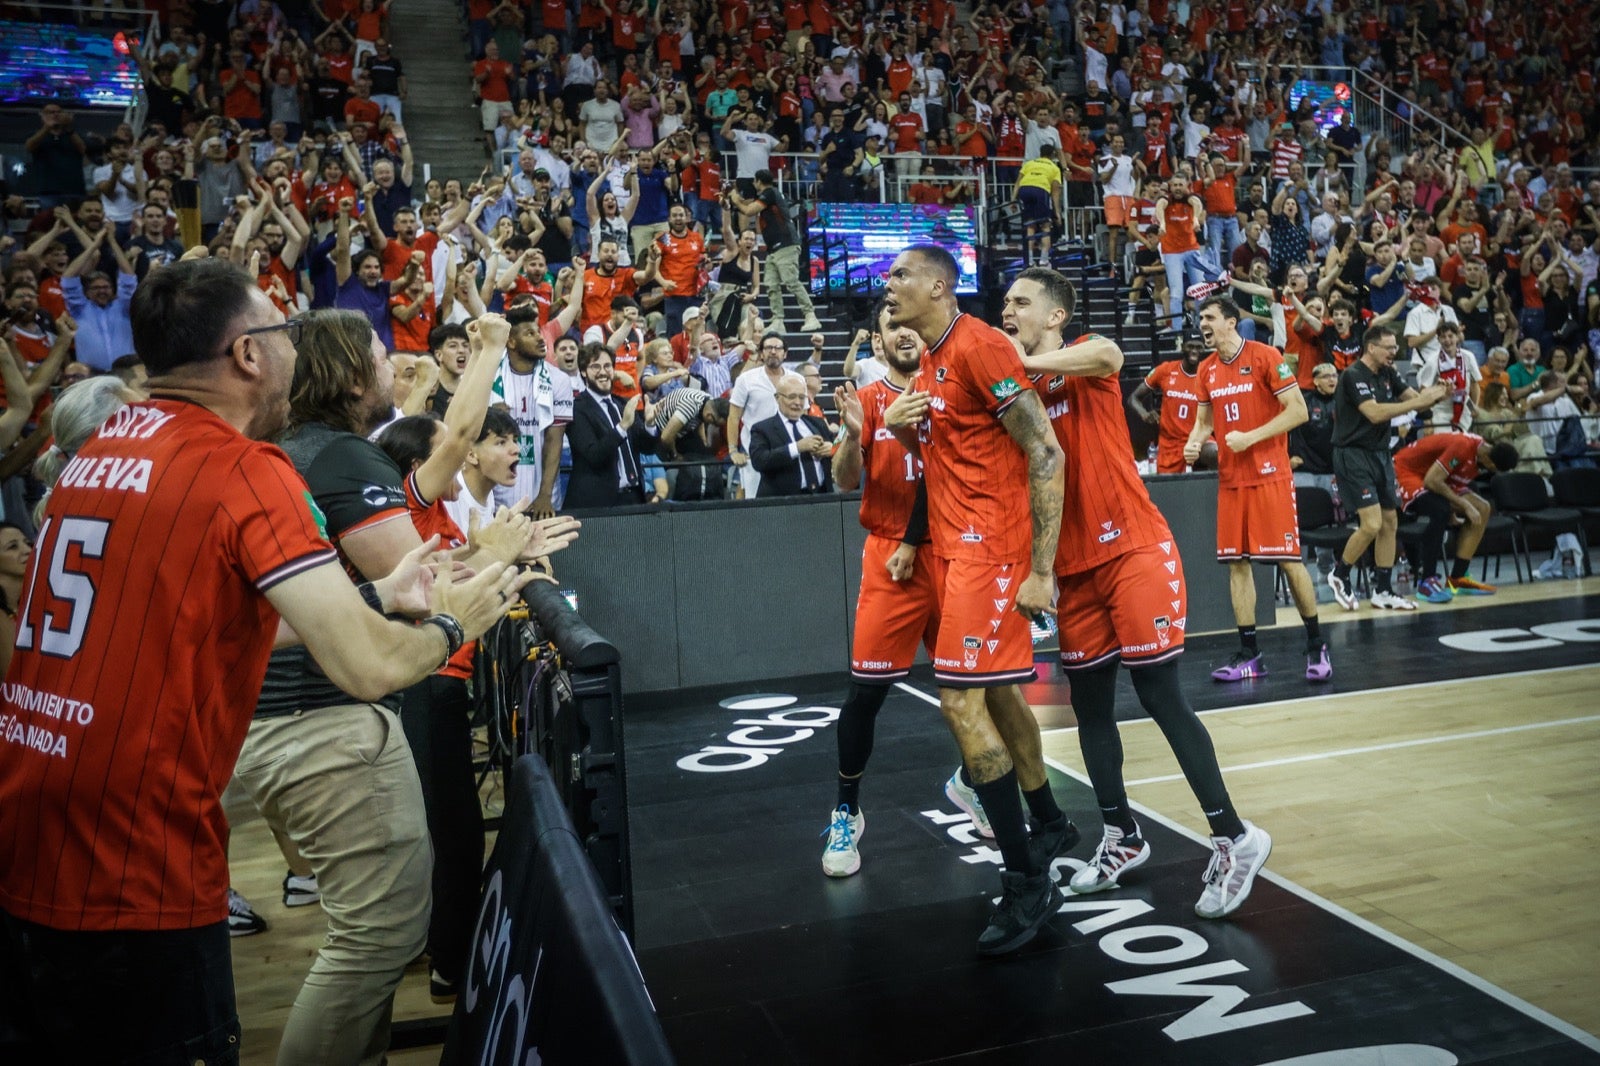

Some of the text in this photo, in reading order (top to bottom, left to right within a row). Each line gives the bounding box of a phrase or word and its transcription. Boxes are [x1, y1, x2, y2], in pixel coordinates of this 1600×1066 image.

[1178, 404, 1189, 419] 0
[1224, 402, 1240, 422] 19
[58, 454, 153, 493] ULEVA
[934, 658, 961, 668] ERNER
